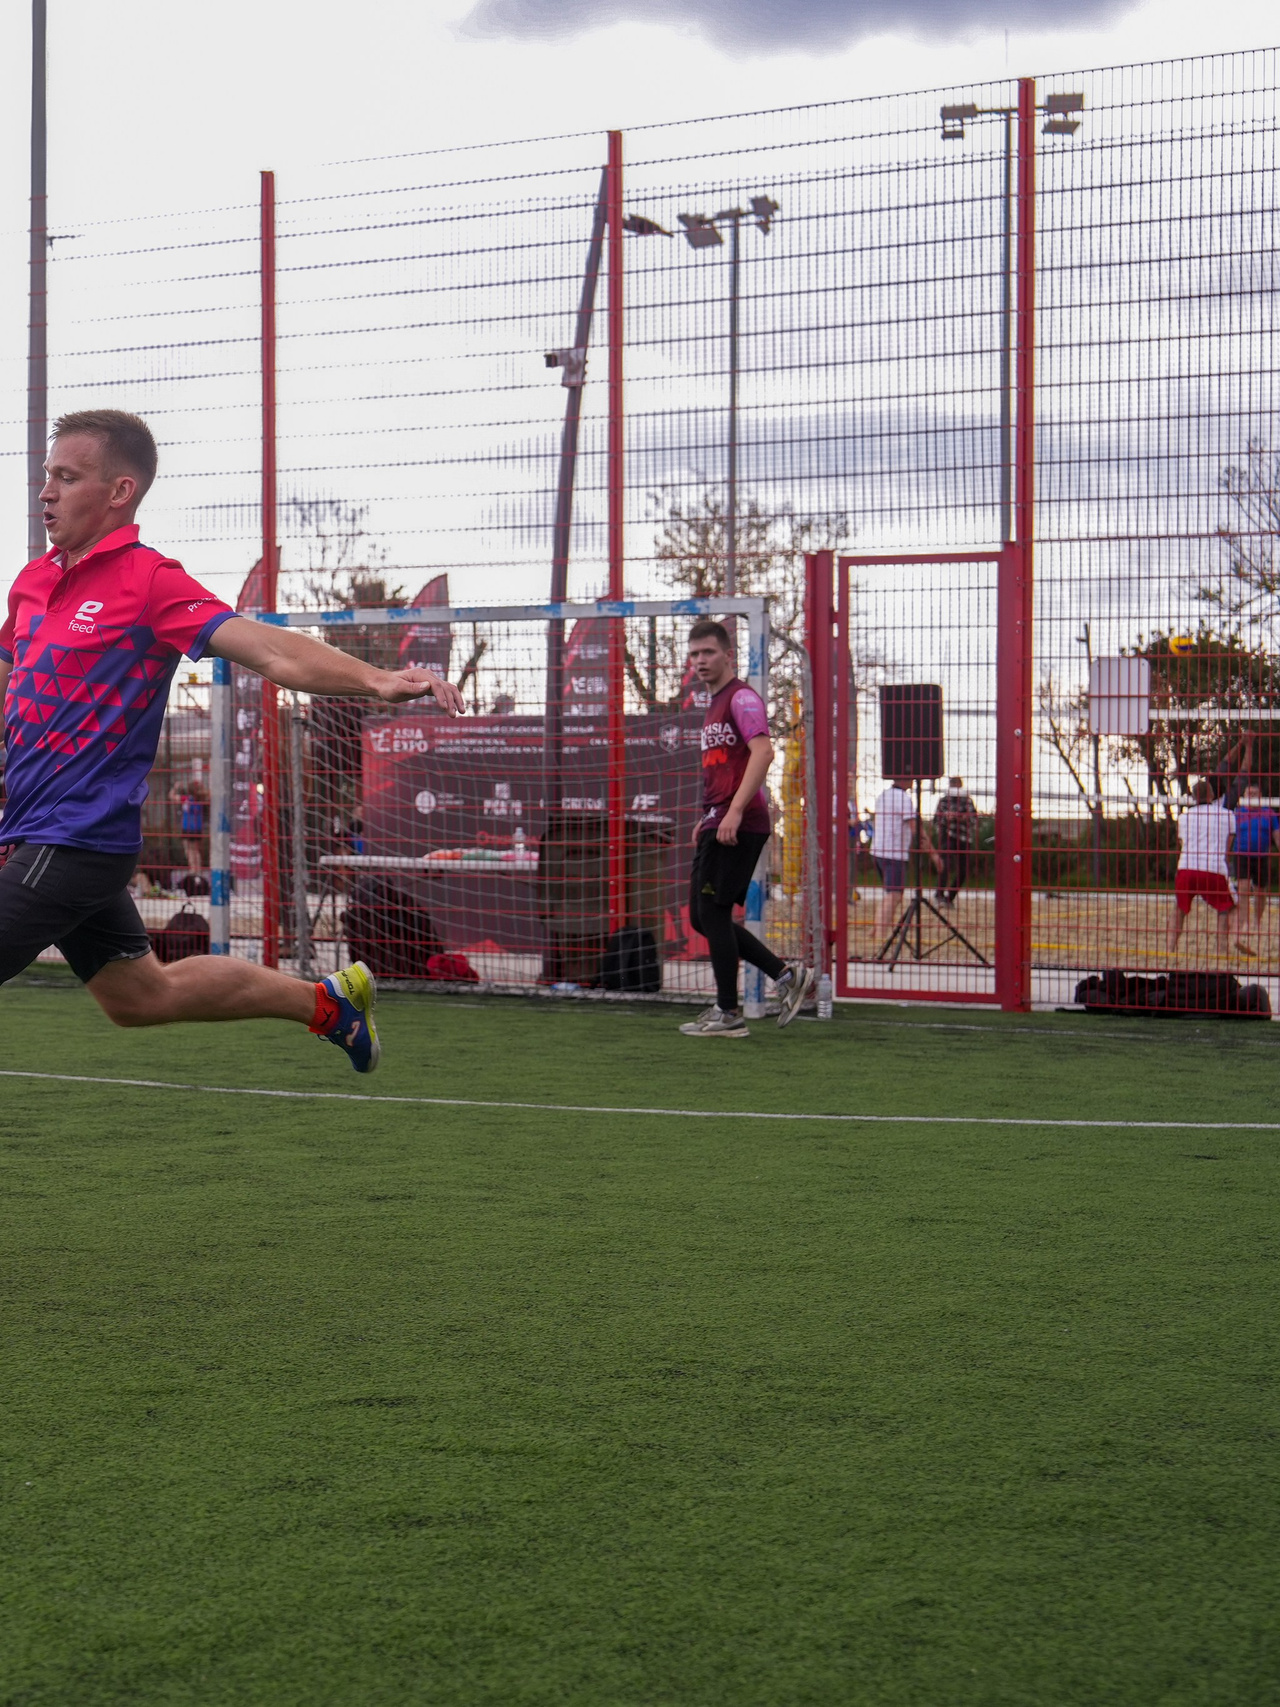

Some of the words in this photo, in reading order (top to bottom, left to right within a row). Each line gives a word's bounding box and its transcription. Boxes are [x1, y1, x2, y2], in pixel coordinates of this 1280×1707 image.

[67, 619, 96, 634] feed
[392, 739, 429, 753] EXPO
[707, 733, 738, 748] EXPO
